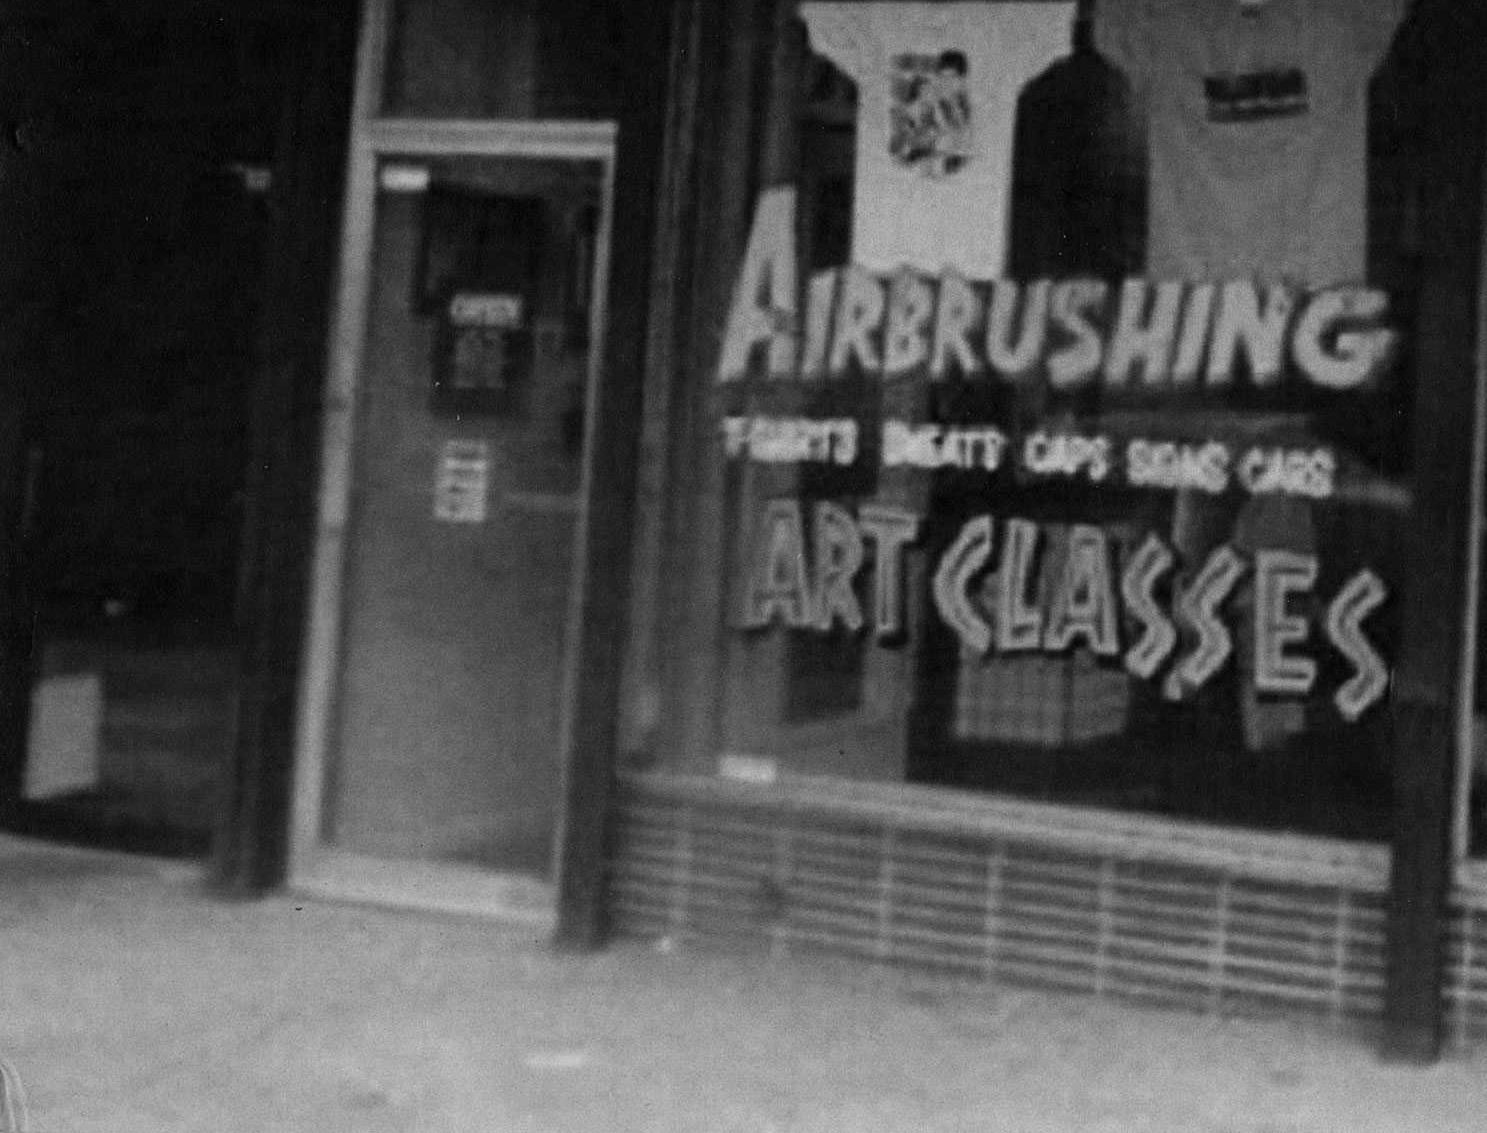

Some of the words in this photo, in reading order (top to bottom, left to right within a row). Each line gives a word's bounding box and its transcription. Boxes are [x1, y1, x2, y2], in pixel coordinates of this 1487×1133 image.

[717, 184, 1398, 390] AIRBRUSHING
[733, 498, 919, 650] ART
[933, 514, 1391, 722] CLASSES
